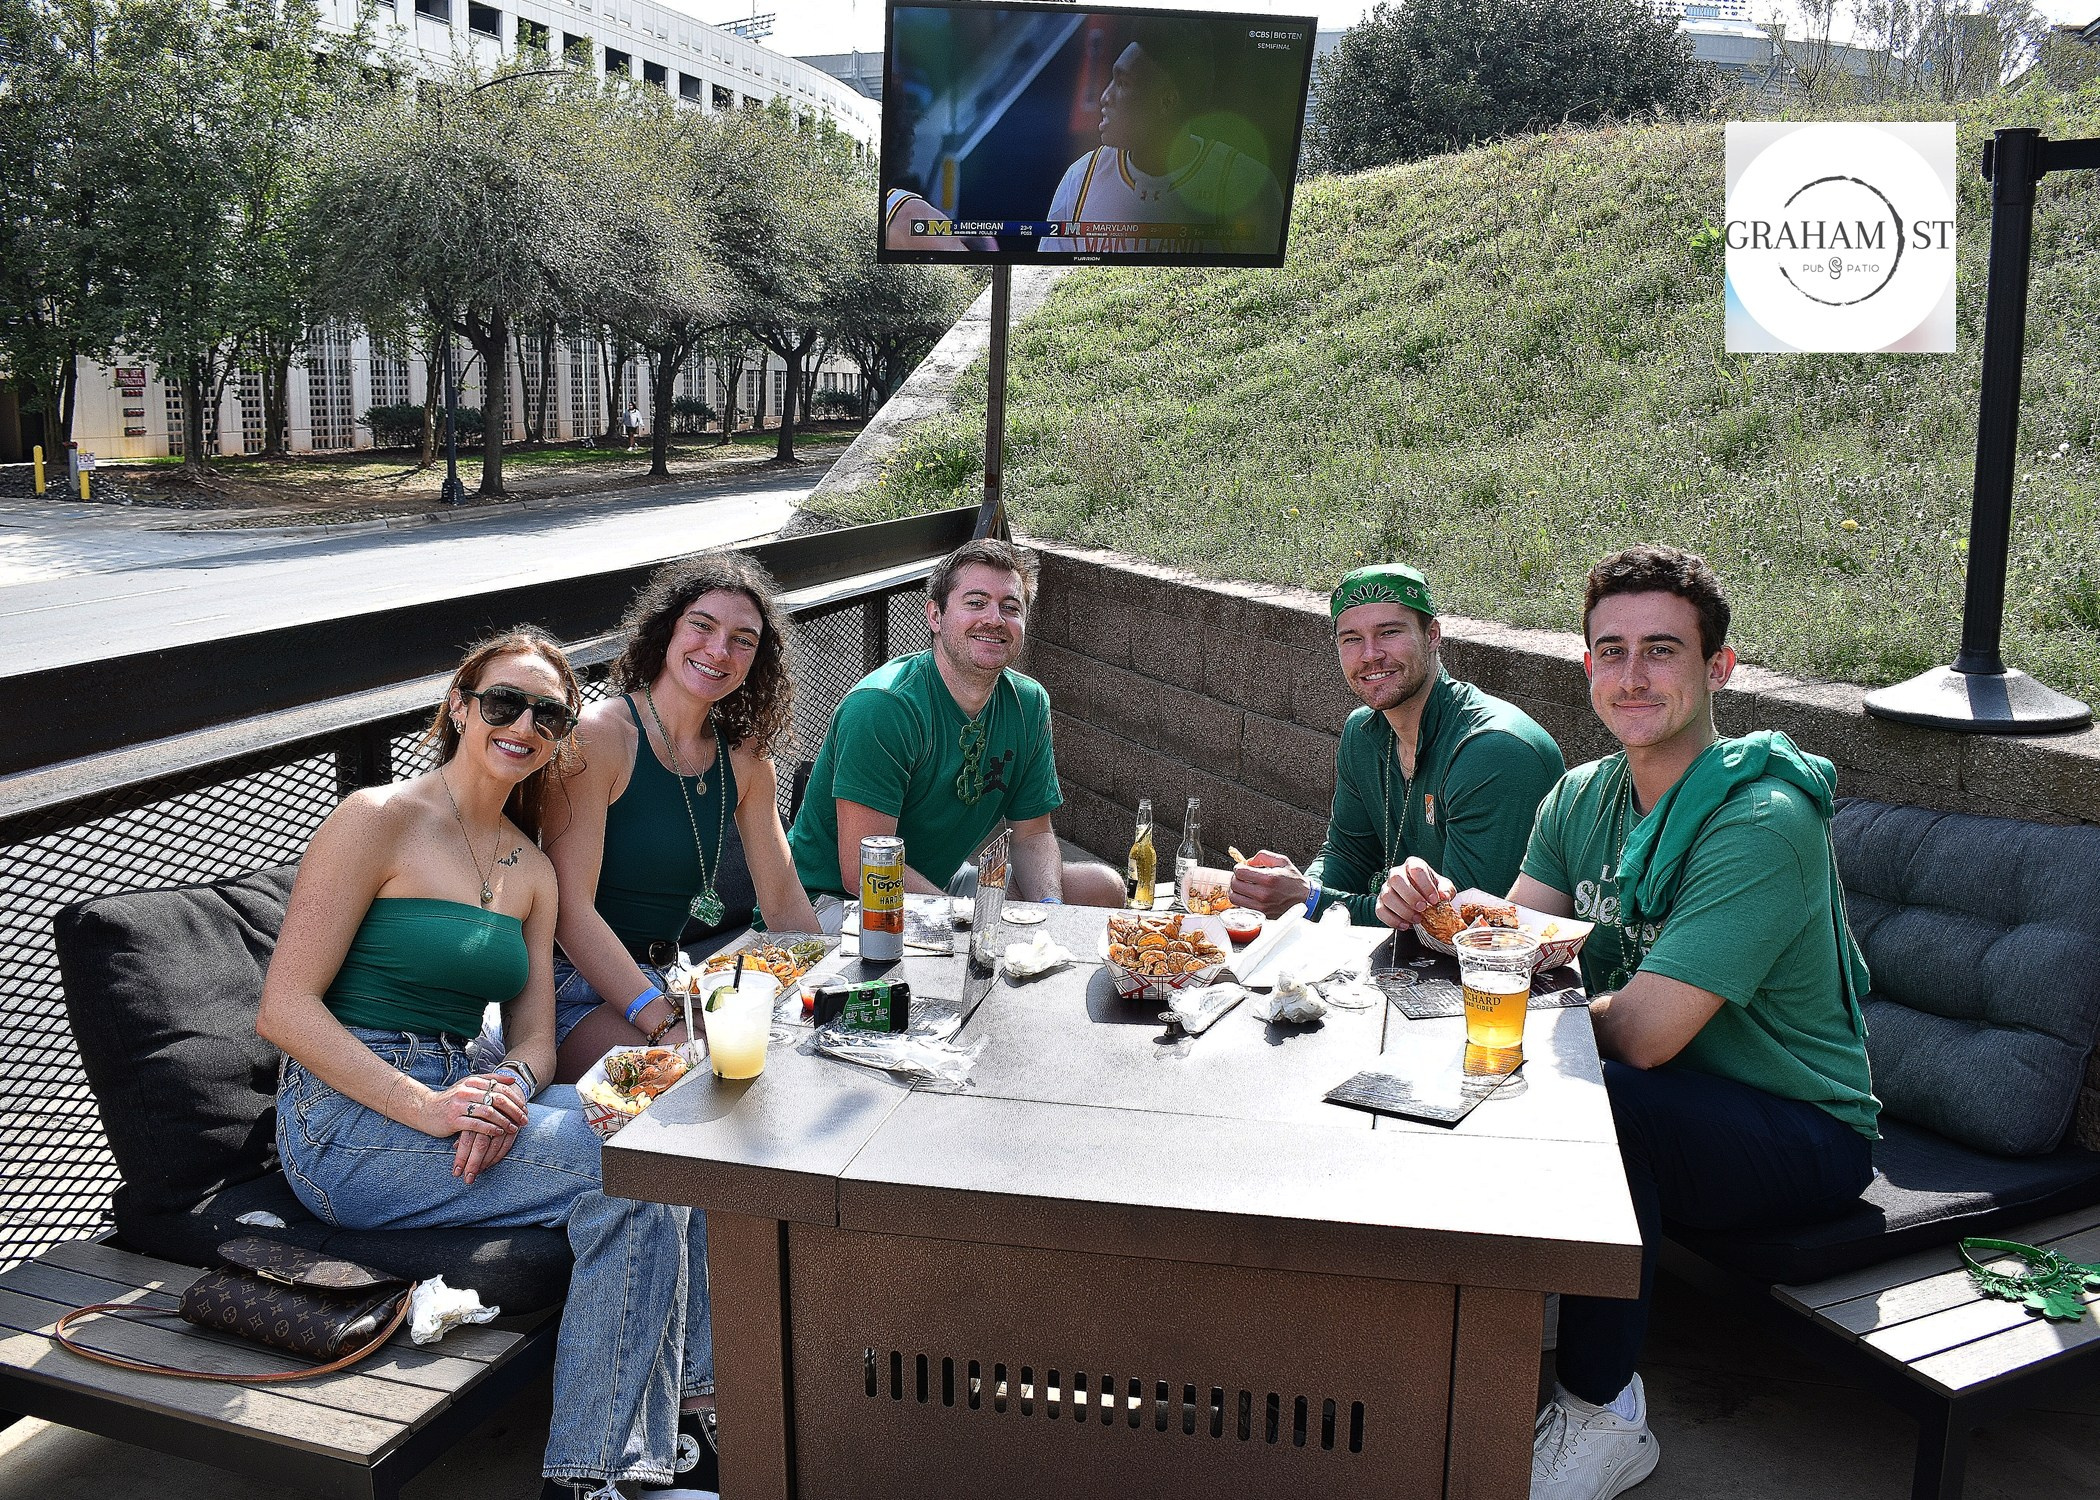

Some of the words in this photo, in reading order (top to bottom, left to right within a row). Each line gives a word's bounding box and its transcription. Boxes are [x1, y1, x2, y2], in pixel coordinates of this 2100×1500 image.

[1255, 31, 1270, 39] CBS
[1273, 31, 1287, 39] BIG
[1288, 32, 1303, 40] TEN
[1257, 42, 1291, 50] SEMIFINAL
[927, 220, 952, 236] M
[960, 222, 1004, 230] MICHIGAN
[1049, 223, 1059, 236] 2
[1092, 224, 1139, 232] MARYLAND
[79, 454, 95, 463] FDC
[1476, 1004, 1494, 1013] CIDER
